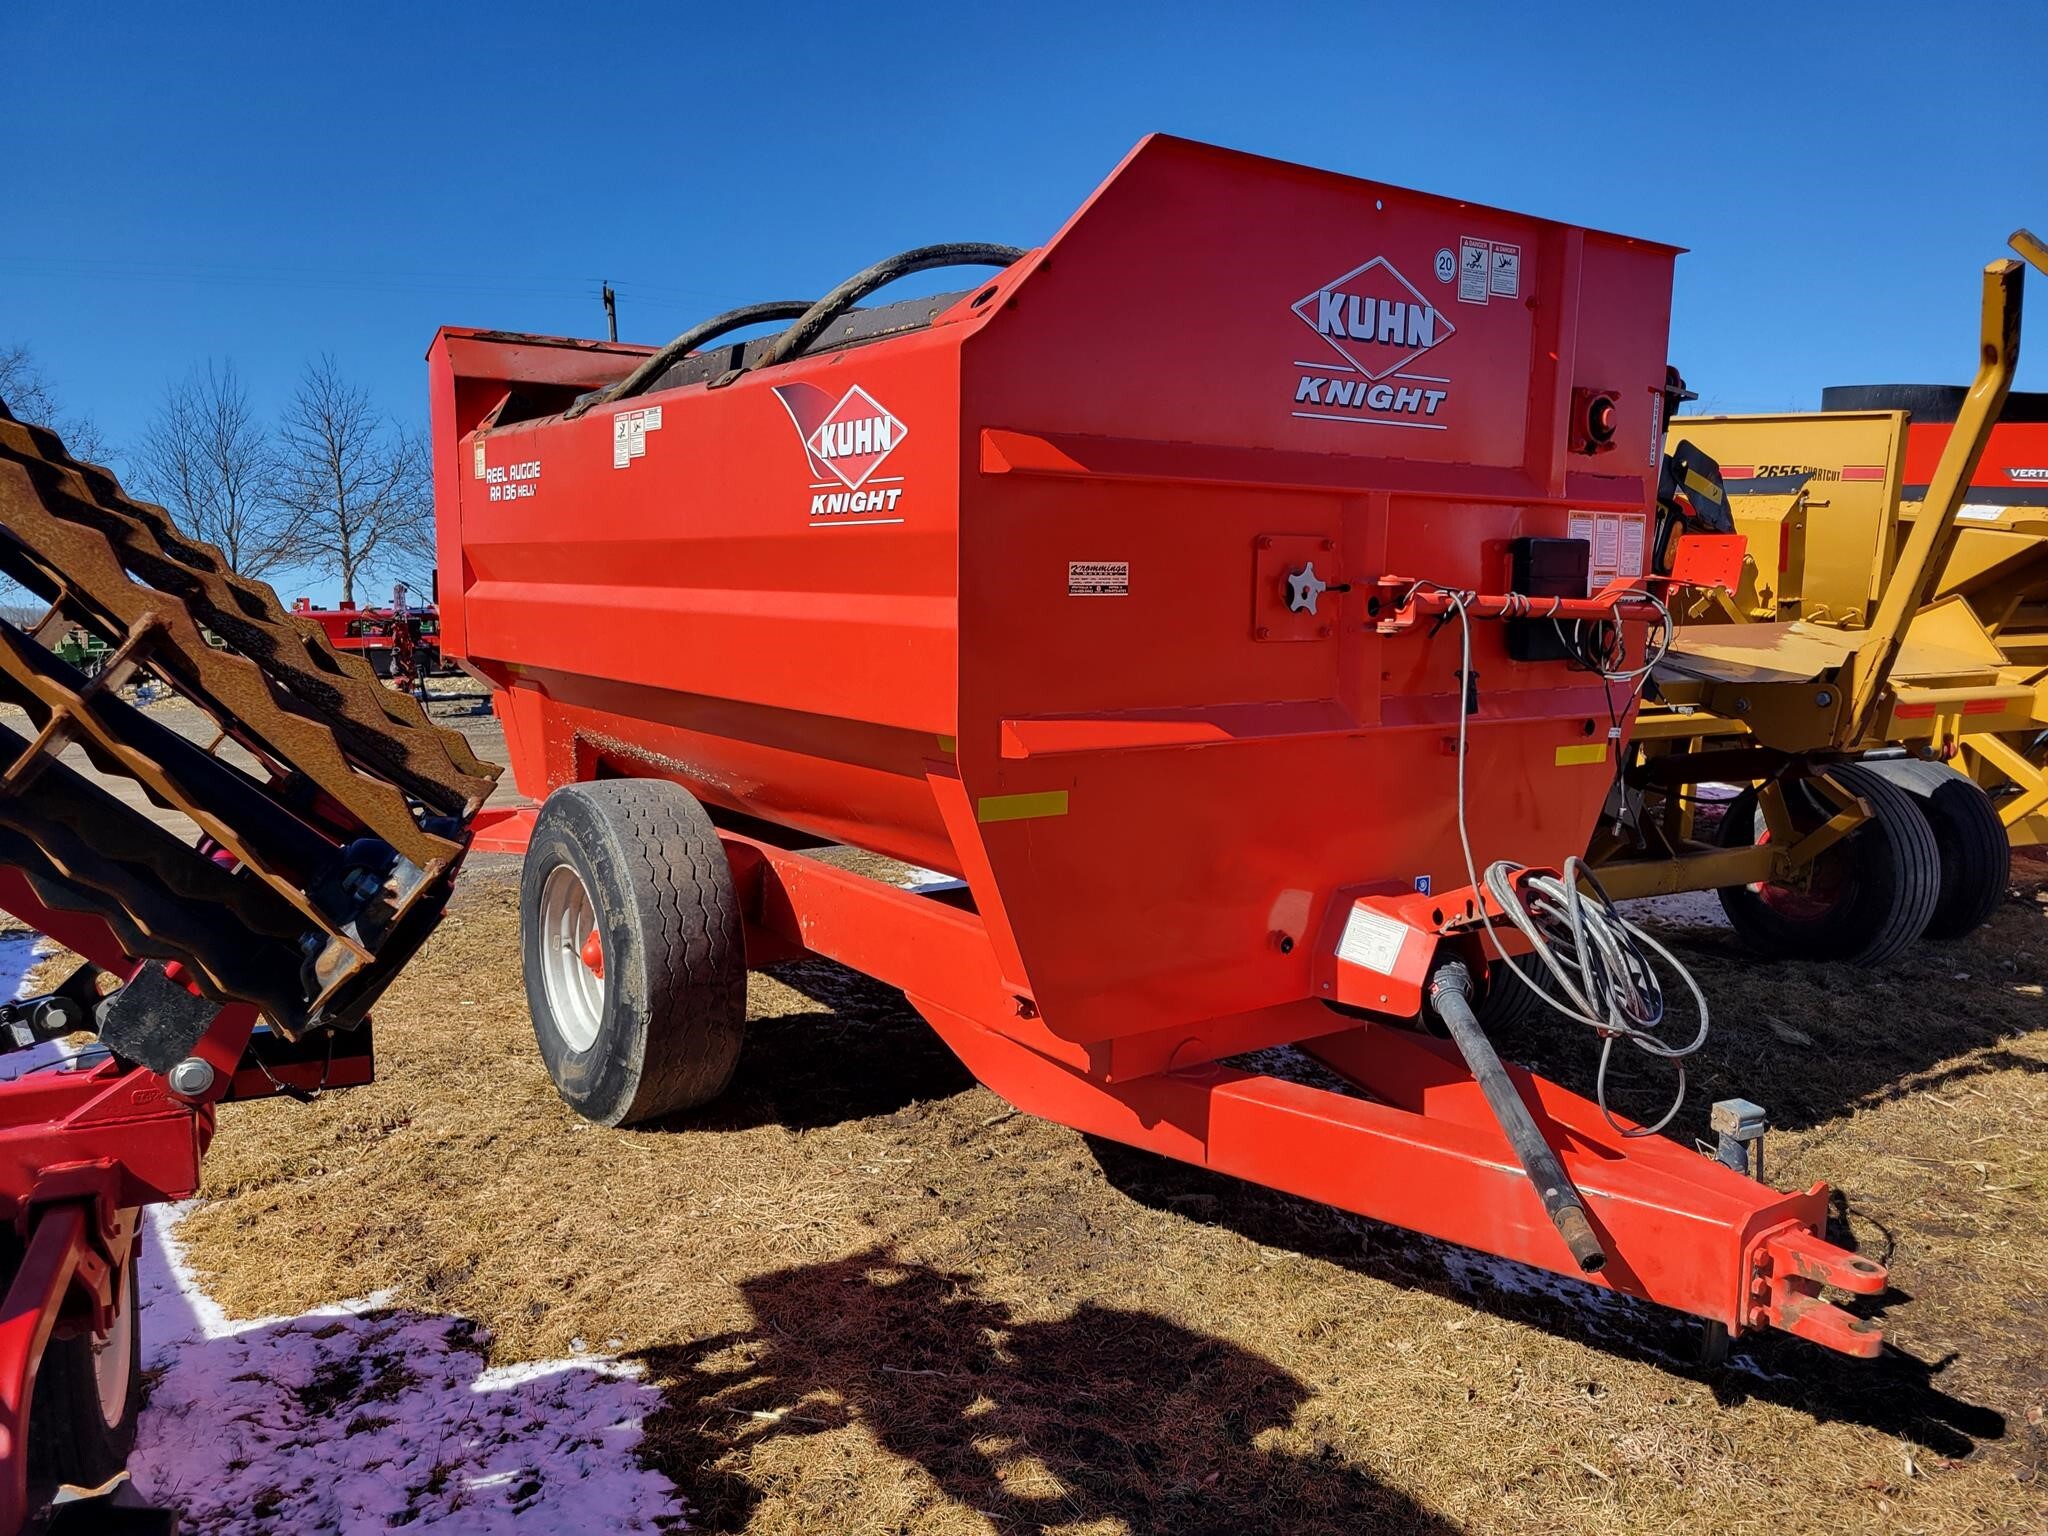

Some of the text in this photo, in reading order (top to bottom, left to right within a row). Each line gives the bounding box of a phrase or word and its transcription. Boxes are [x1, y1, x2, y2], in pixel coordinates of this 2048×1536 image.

[1469, 240, 1488, 249] DANGER
[1439, 256, 1452, 271] 20
[1318, 290, 1434, 348] KUHN
[1295, 376, 1446, 415] KNIGHT
[821, 415, 891, 459] KUHN
[486, 461, 541, 483] REEL AUGGIE
[1755, 465, 1802, 478] 2655
[490, 485, 501, 501] RA
[503, 484, 516, 501] 136
[810, 488, 902, 515] KNIGHT
